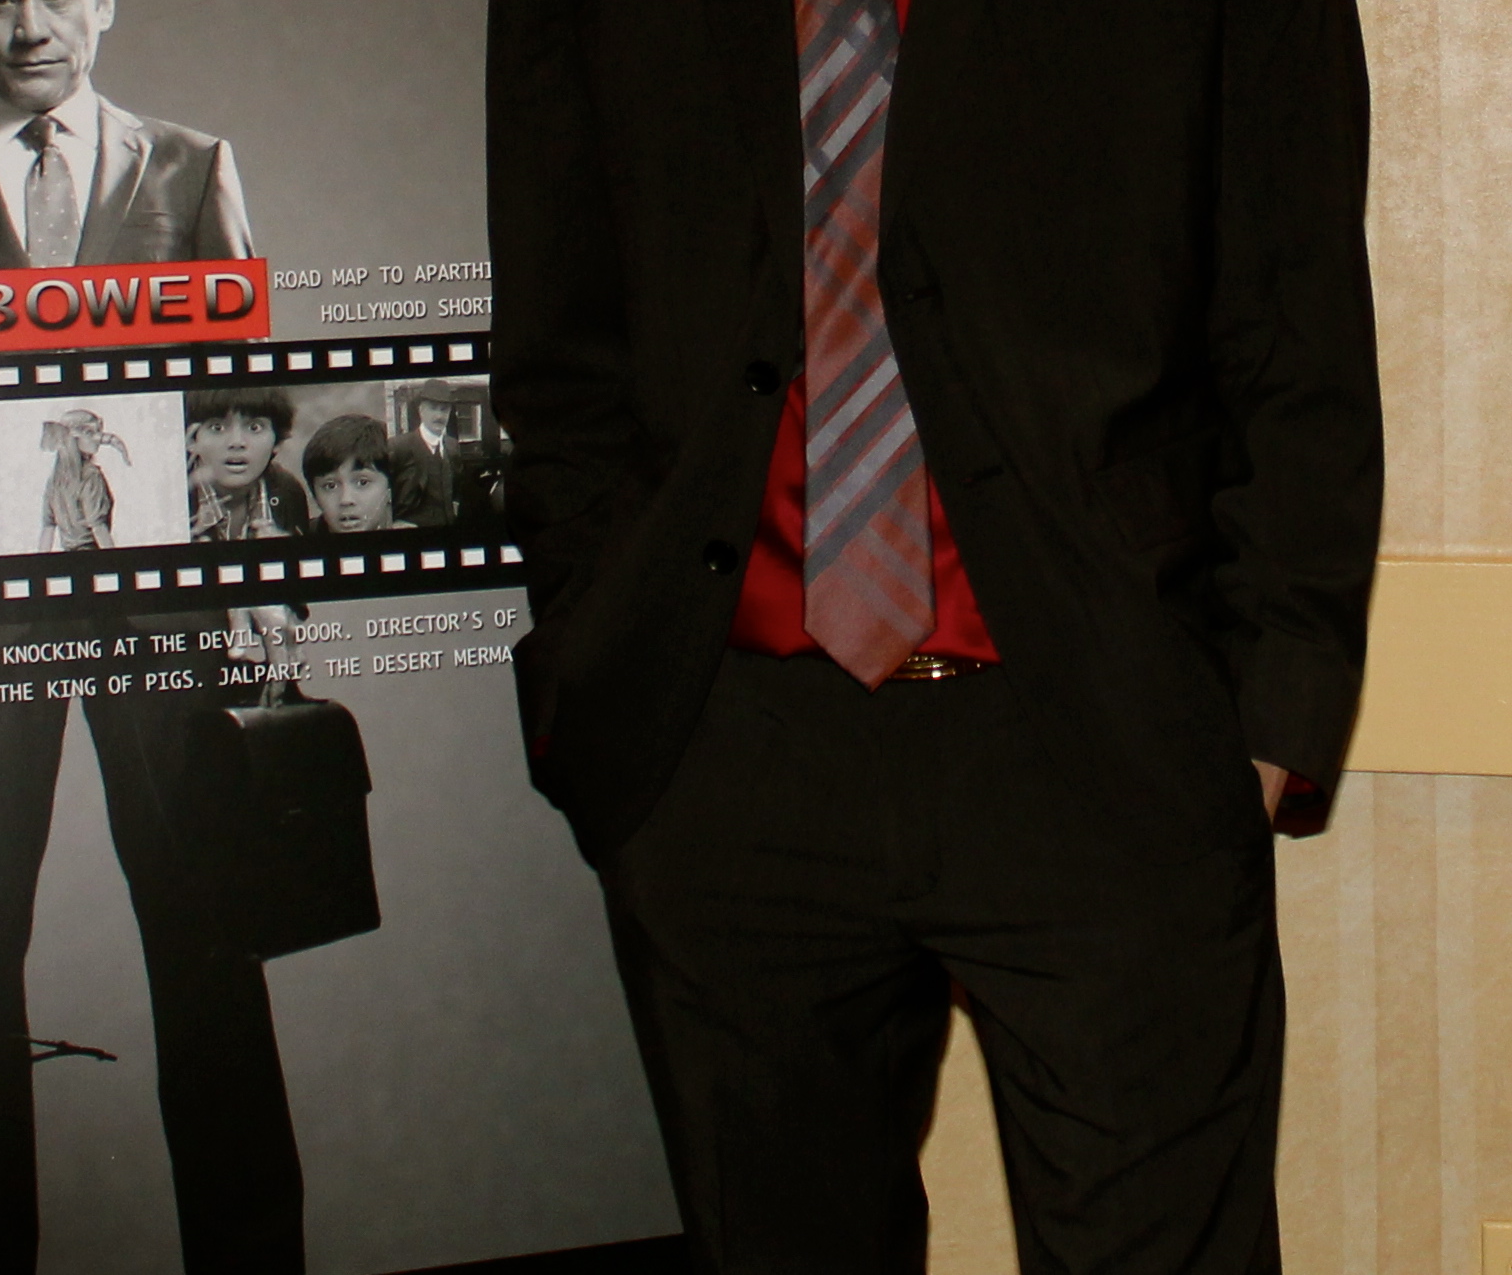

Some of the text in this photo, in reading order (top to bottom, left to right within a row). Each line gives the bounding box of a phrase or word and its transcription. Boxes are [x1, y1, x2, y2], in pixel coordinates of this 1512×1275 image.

[273, 269, 321, 289] ROAD
[331, 267, 368, 286] MAP
[378, 265, 403, 283] TO
[321, 300, 426, 322] HOLLYWOOD
[2, 639, 102, 665] KNOCKING
[113, 637, 139, 657] AT
[149, 633, 187, 654] THE
[291, 622, 351, 642] DOOR.
[494, 608, 517, 627] OF
[46, 677, 97, 699] KING
[108, 674, 133, 695] OF
[145, 669, 203, 691] PIGS.
[218, 662, 310, 686] JALPARI:
[324, 656, 361, 677] THE
[373, 650, 443, 673] DESERT
